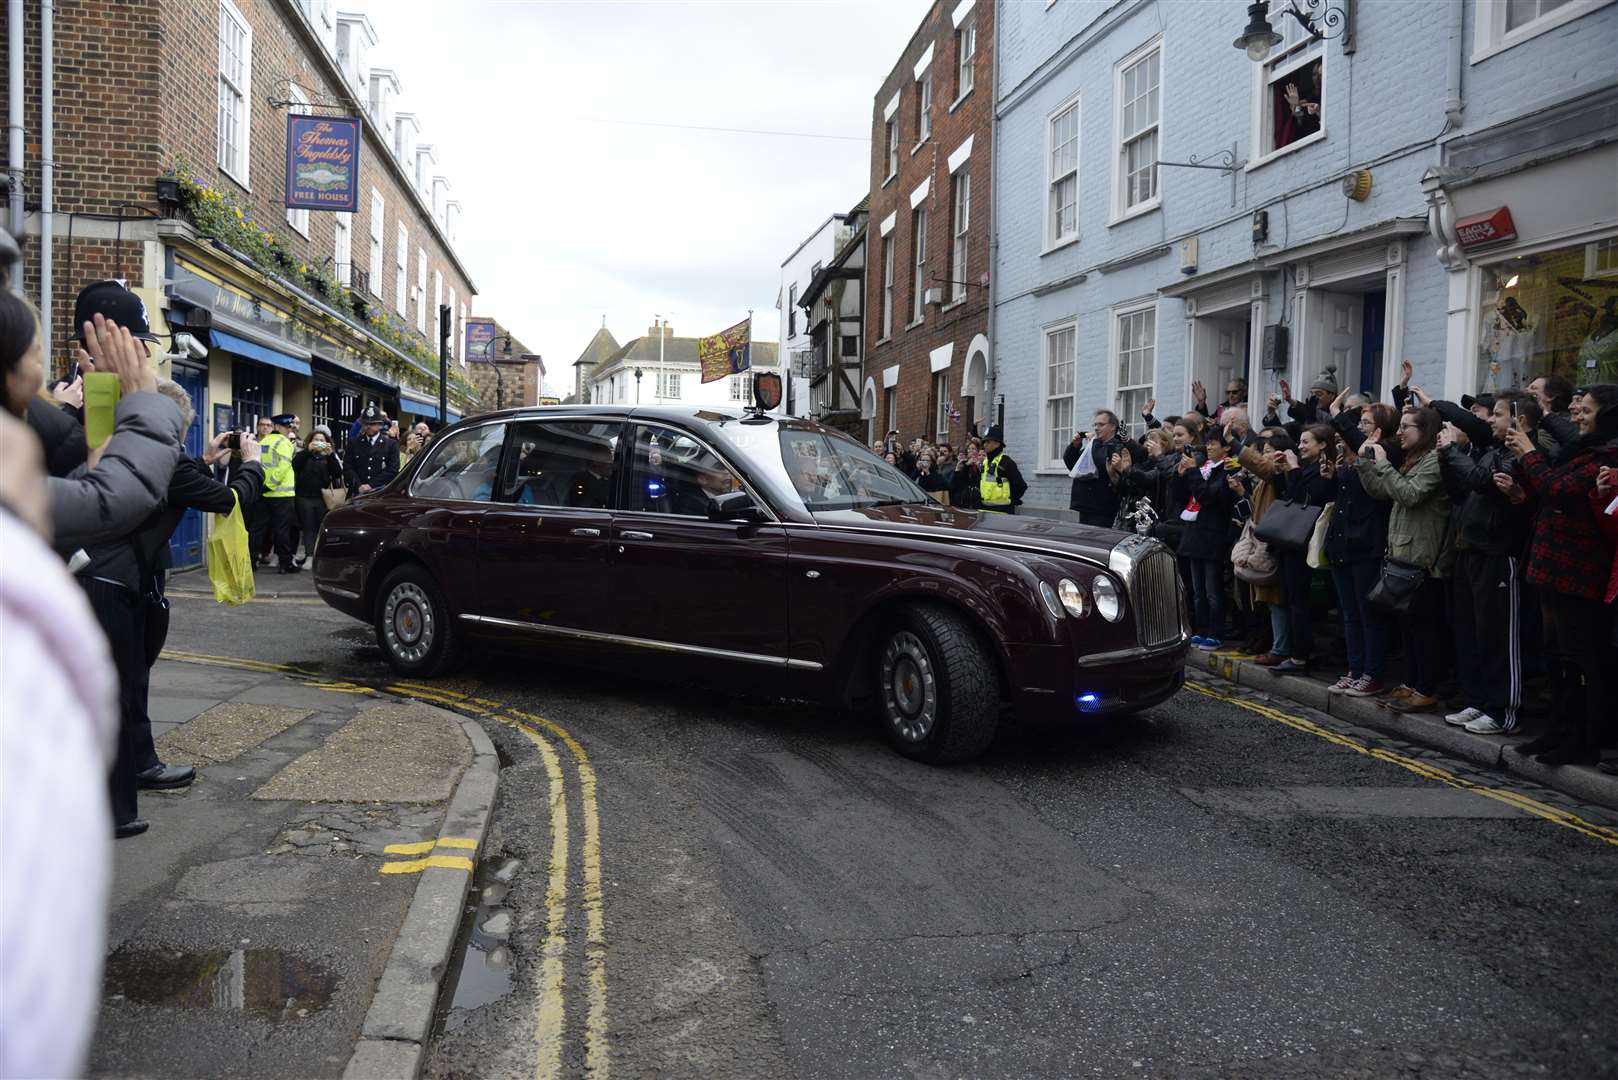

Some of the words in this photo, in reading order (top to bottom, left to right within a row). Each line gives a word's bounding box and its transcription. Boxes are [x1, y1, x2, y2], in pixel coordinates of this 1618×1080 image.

[314, 122, 333, 132] The
[301, 131, 349, 146] Thomas
[295, 144, 351, 164] Ingoldsby
[294, 191, 315, 200] FREE
[319, 192, 348, 201] HOUSE
